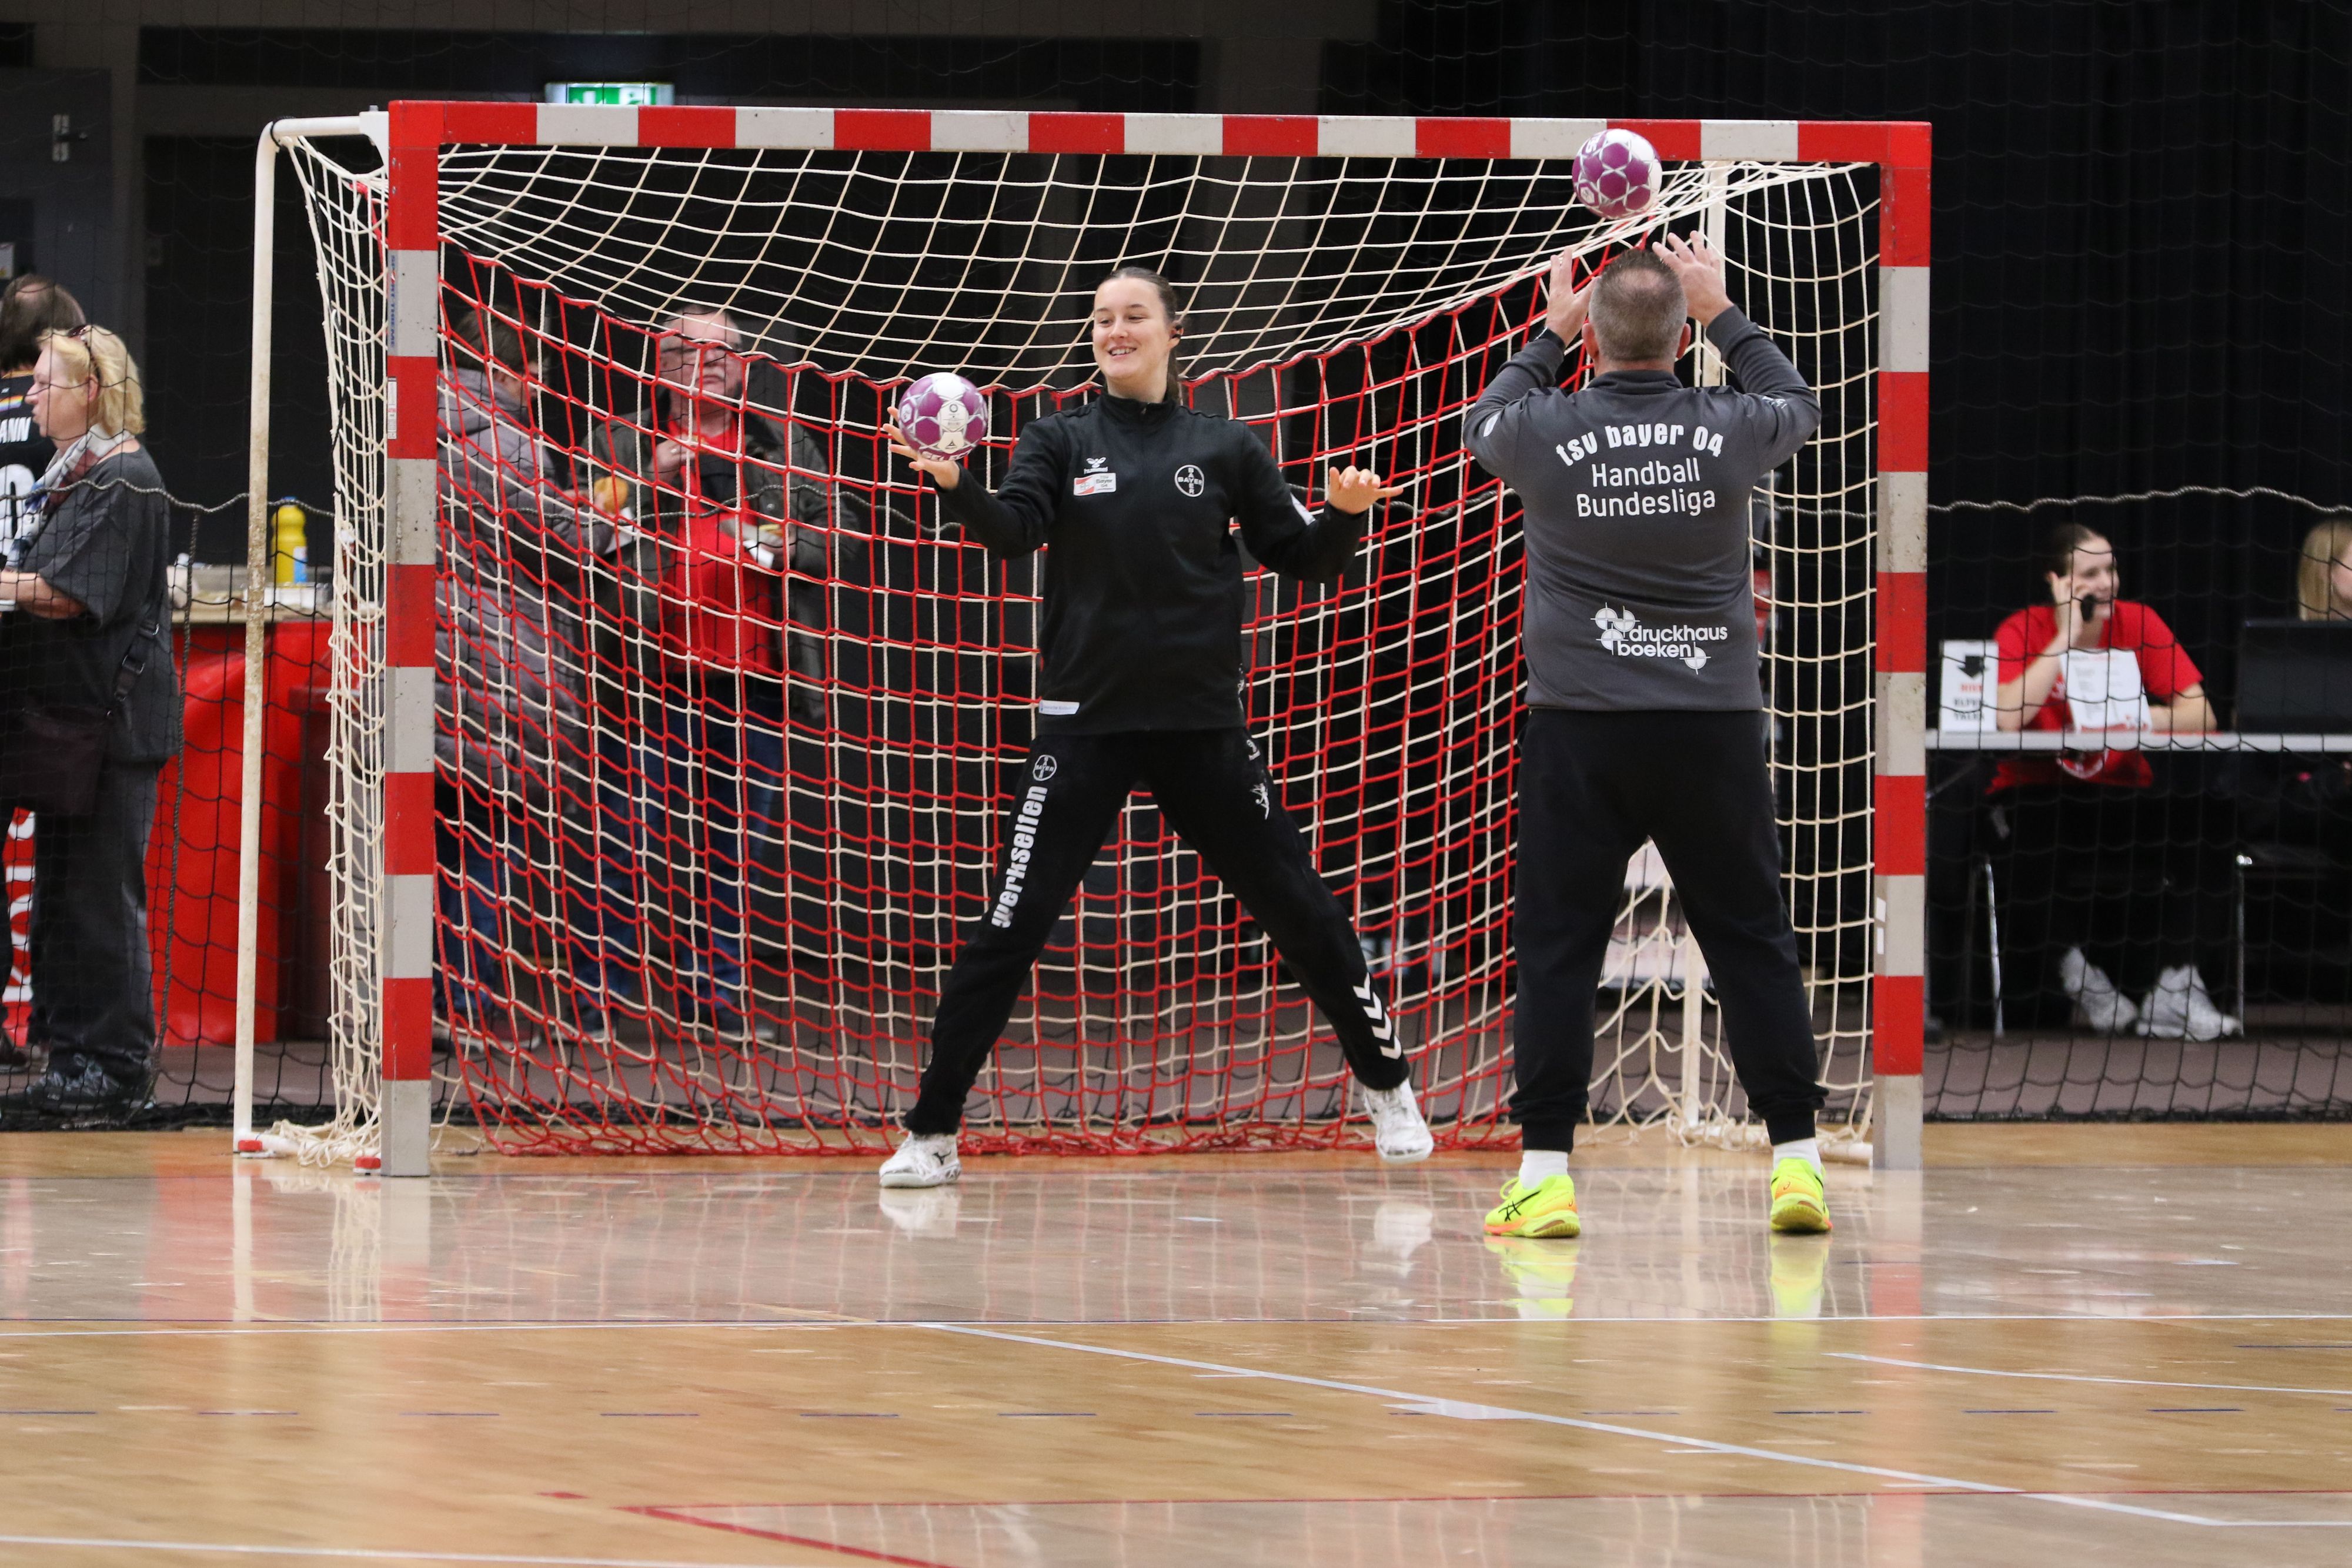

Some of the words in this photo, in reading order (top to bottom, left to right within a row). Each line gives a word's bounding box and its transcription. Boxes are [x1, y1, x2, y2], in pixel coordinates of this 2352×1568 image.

[0, 416, 32, 444] ANN
[1556, 432, 1598, 466] tsv
[1605, 423, 1684, 449] bayer
[1693, 426, 1724, 457] 04
[1178, 477, 1202, 486] BAYER
[1592, 457, 1700, 487] Handball
[1576, 488, 1716, 517] Bundesliga
[1629, 625, 1728, 642] druckhaus
[1617, 640, 1692, 657] boeken
[991, 785, 1048, 929] werkselfen
